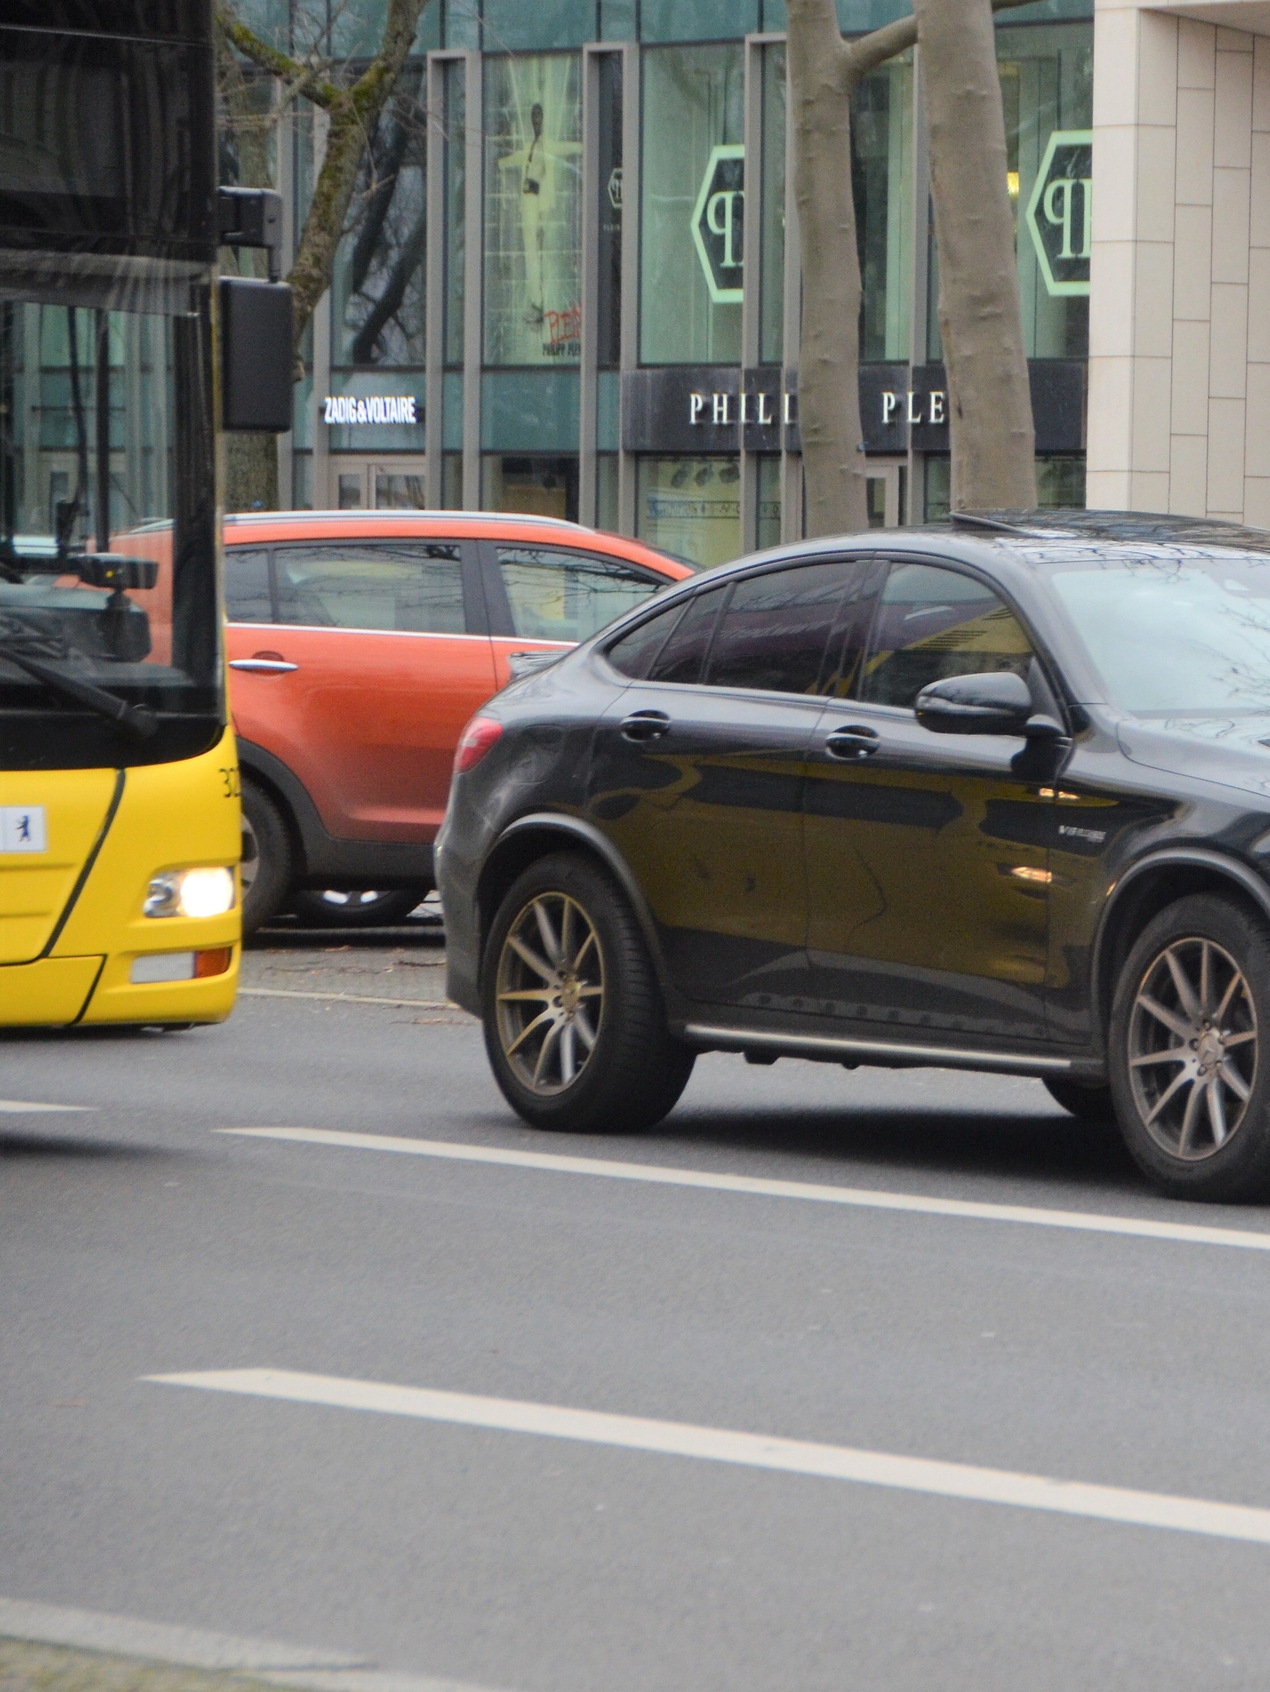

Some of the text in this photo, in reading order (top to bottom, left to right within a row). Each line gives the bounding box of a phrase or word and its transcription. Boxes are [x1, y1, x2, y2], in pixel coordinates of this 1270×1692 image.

[324, 395, 416, 424] ZADIG&VOLTAIRE
[689, 391, 945, 424] PHILI PLE
